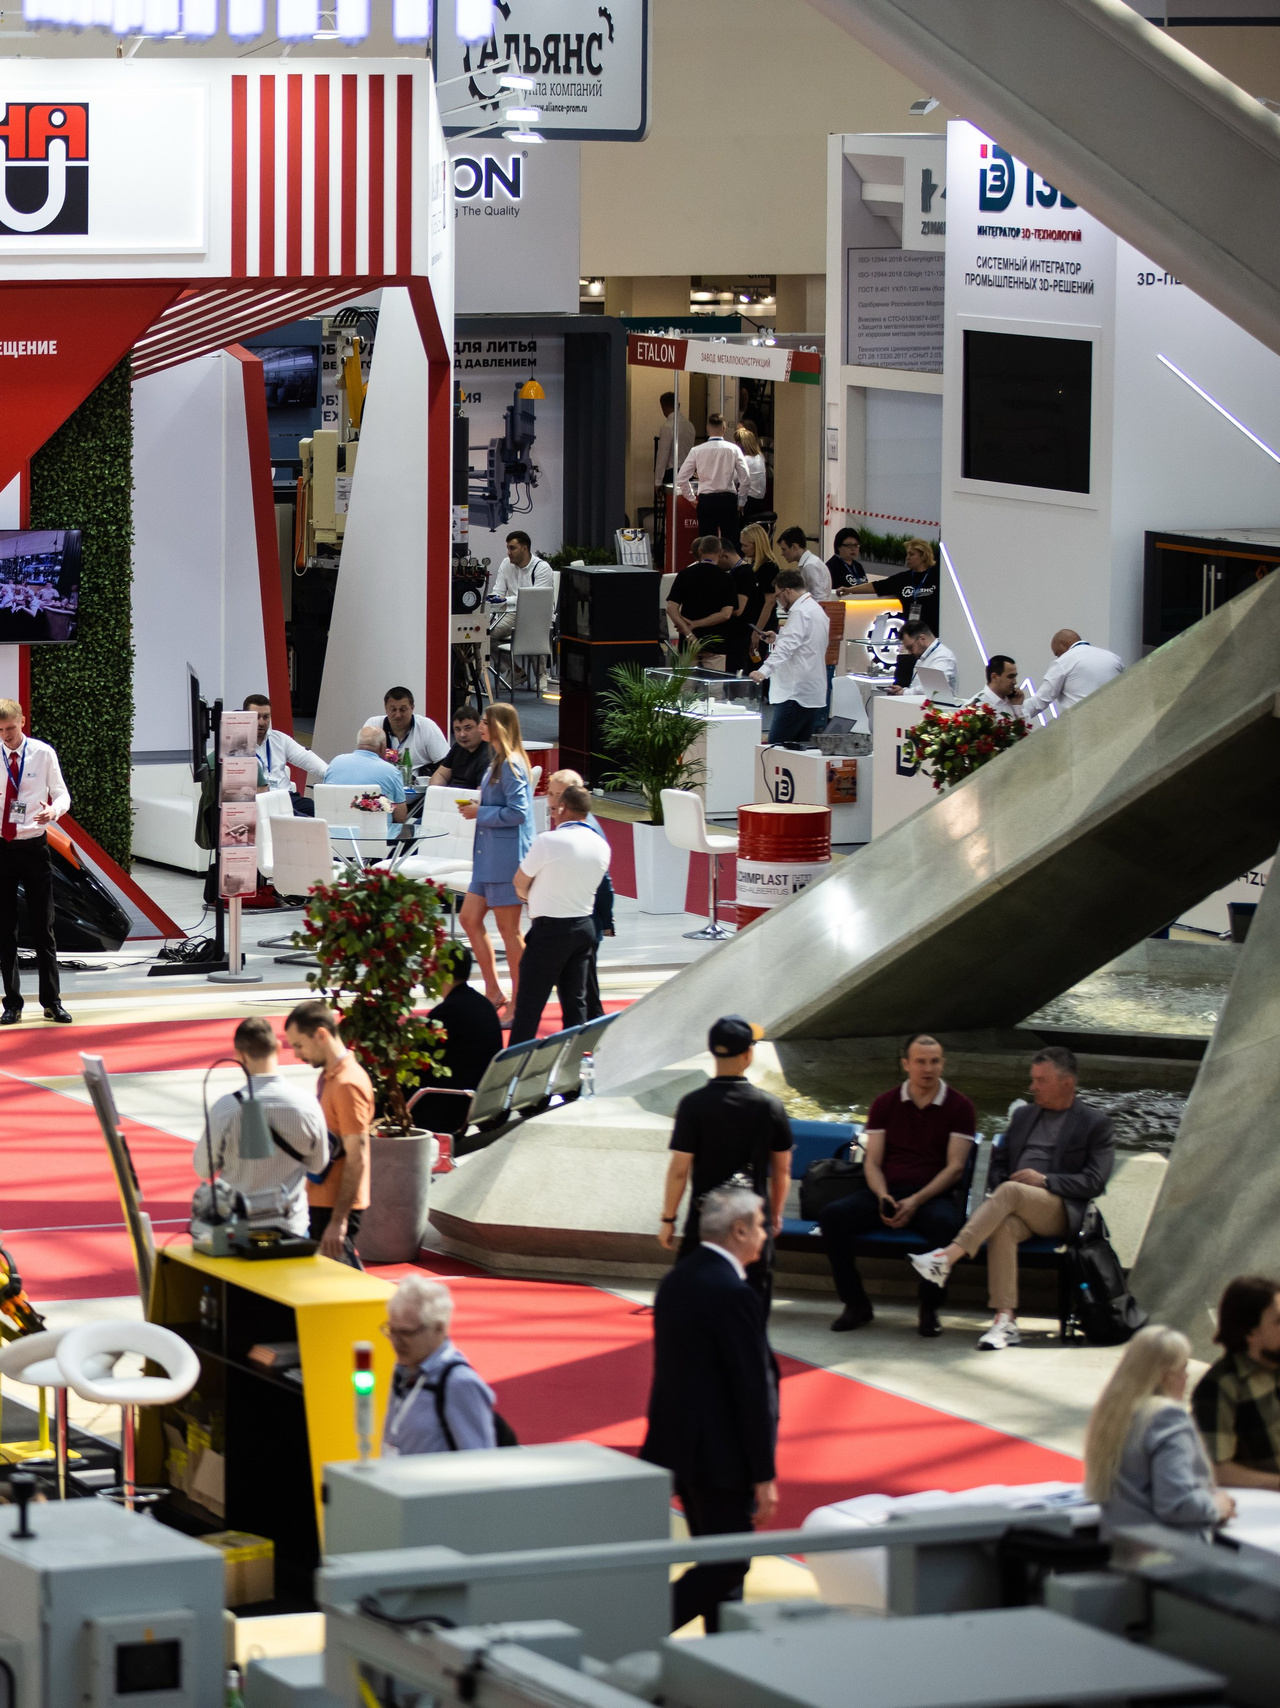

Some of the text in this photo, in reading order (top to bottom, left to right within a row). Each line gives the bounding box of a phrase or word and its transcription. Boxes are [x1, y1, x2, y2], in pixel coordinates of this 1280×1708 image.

[549, 79, 603, 98] компаний
[462, 206, 481, 216] The
[484, 206, 520, 218] Quality
[977, 225, 1082, 242] ИНТЕГРАТОР 3D-ТЕХНОЛОГИЙ
[976, 255, 1081, 275] СИСТЕМНЫЙ ИНТЕГРАТОР
[965, 272, 1095, 295] ПРОМЫШЛЕННЫХ 3D-РЕШЕНИЙ
[891, 300, 925, 308] Российского
[487, 341, 537, 353] ЛИТЬЯ
[636, 341, 676, 364] ETALON
[464, 358, 537, 369] ДАВЛЕНИЕМ
[701, 352, 771, 369] ЗАВОД МЕТАЛЛОКОНСТРУКЦИЙ
